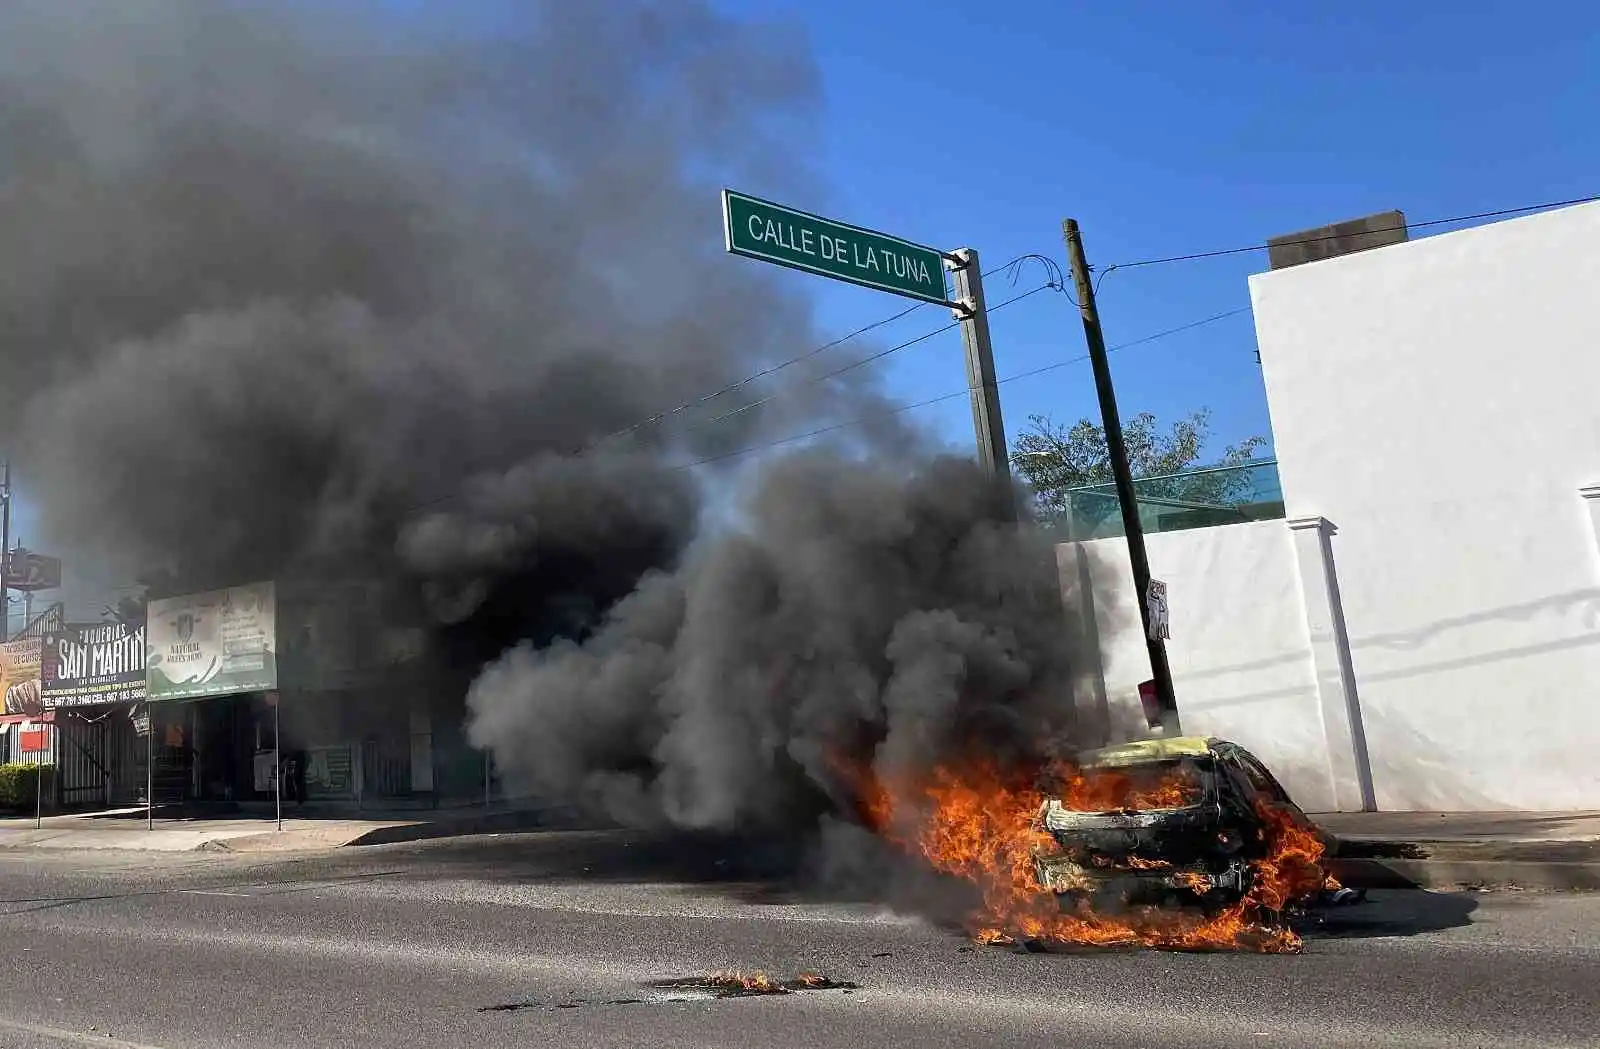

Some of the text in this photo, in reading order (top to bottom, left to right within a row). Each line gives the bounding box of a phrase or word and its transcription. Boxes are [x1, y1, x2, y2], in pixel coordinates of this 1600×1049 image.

[748, 214, 932, 285] CALLE DE LA TUNA
[58, 625, 145, 680] SAN MARTIN
[79, 623, 126, 644] TAQUERIAS
[41, 698, 55, 707] TEL:
[92, 694, 106, 703] CEL:
